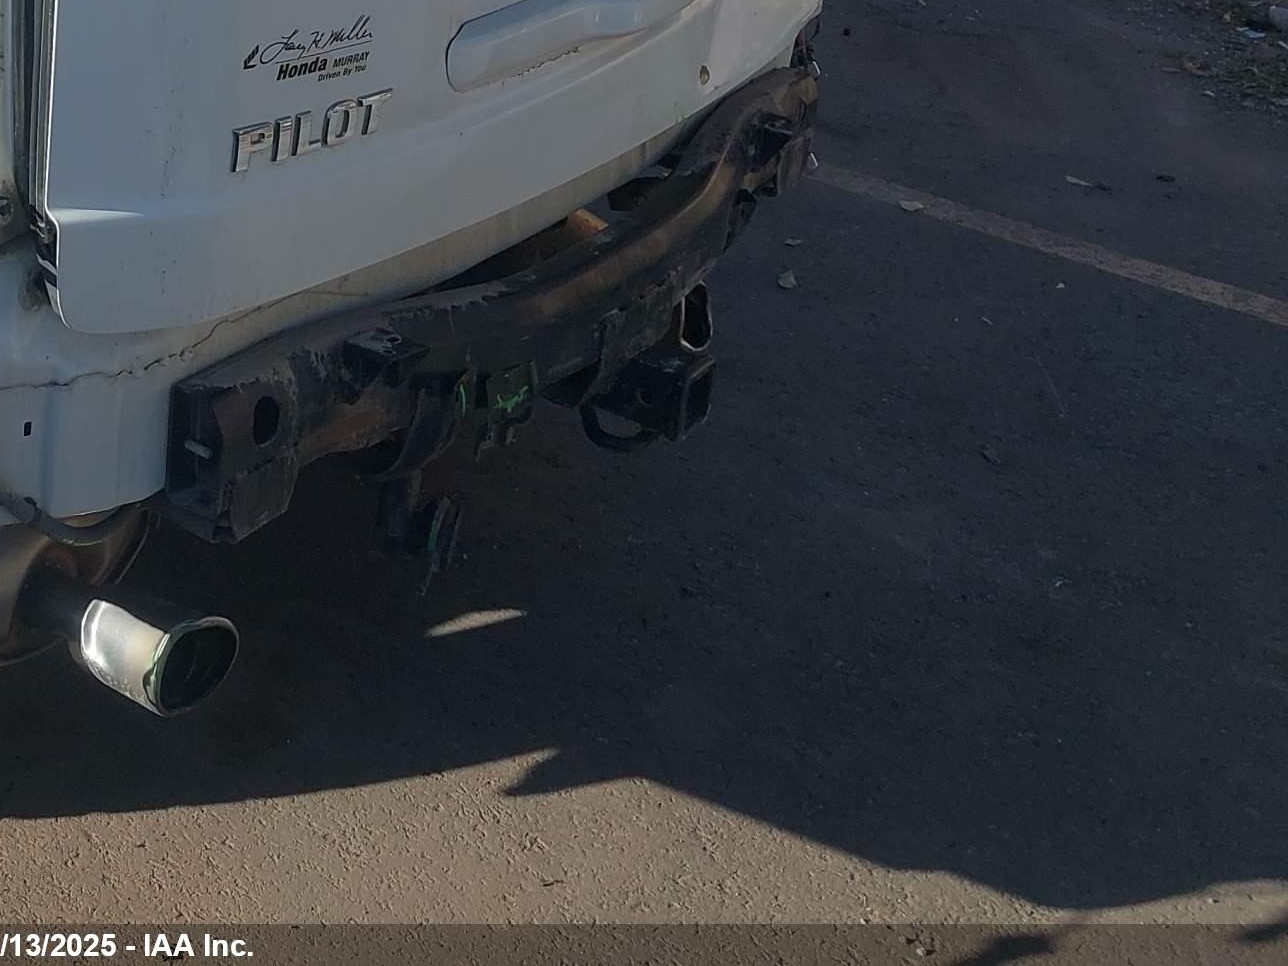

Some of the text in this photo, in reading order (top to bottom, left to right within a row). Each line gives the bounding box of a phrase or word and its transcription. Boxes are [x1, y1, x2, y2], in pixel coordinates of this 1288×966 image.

[276, 51, 370, 81] Honda MURRAY
[317, 64, 368, 82] Driven By You
[230, 87, 393, 173] PILOT
